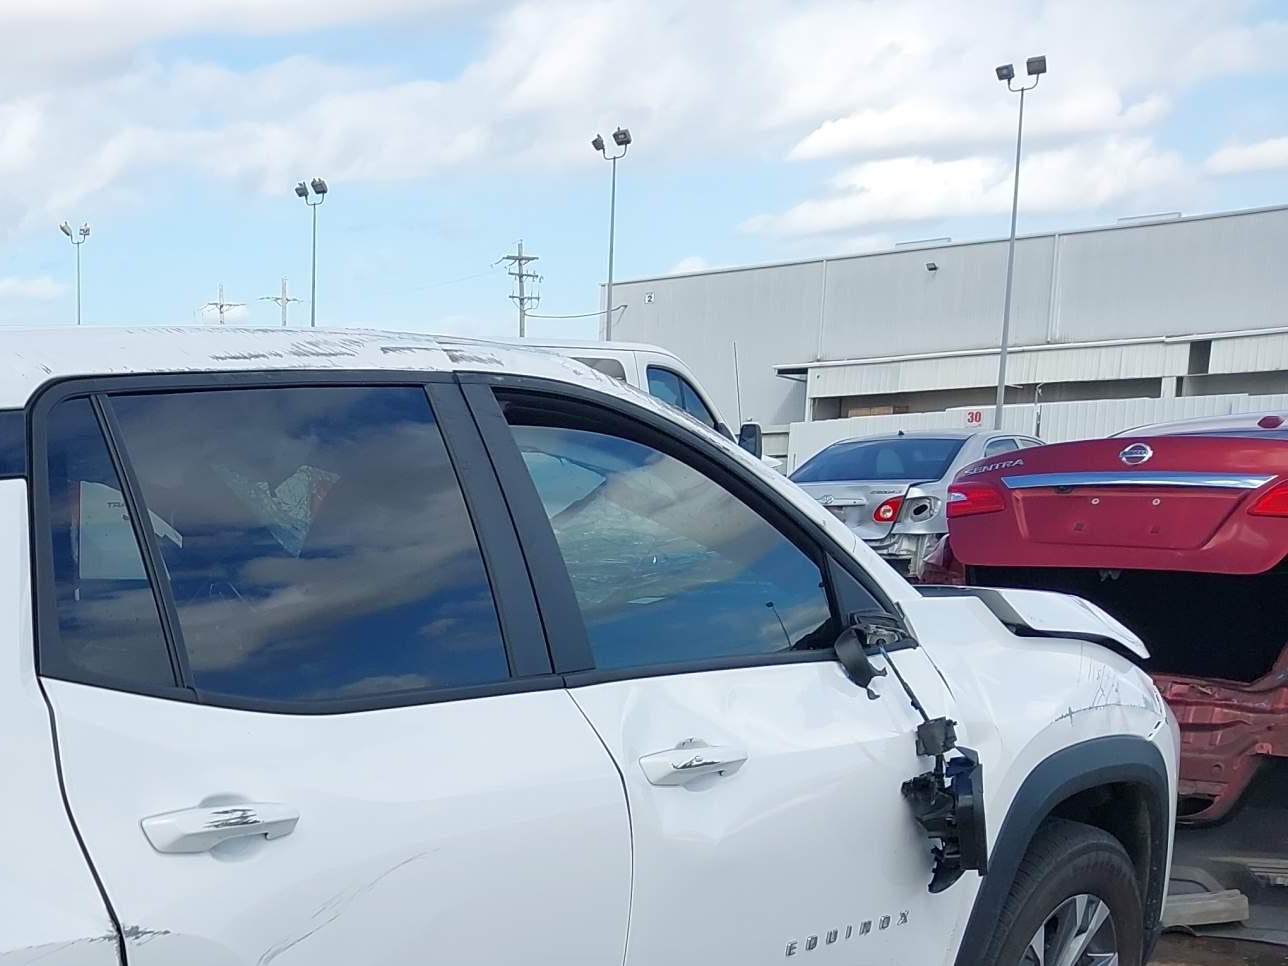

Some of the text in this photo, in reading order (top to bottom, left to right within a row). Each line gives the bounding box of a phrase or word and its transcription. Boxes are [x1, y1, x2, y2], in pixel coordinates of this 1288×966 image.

[967, 411, 982, 423] 30
[964, 459, 1024, 475] SENTRA
[785, 910, 910, 957] EQUINOX
